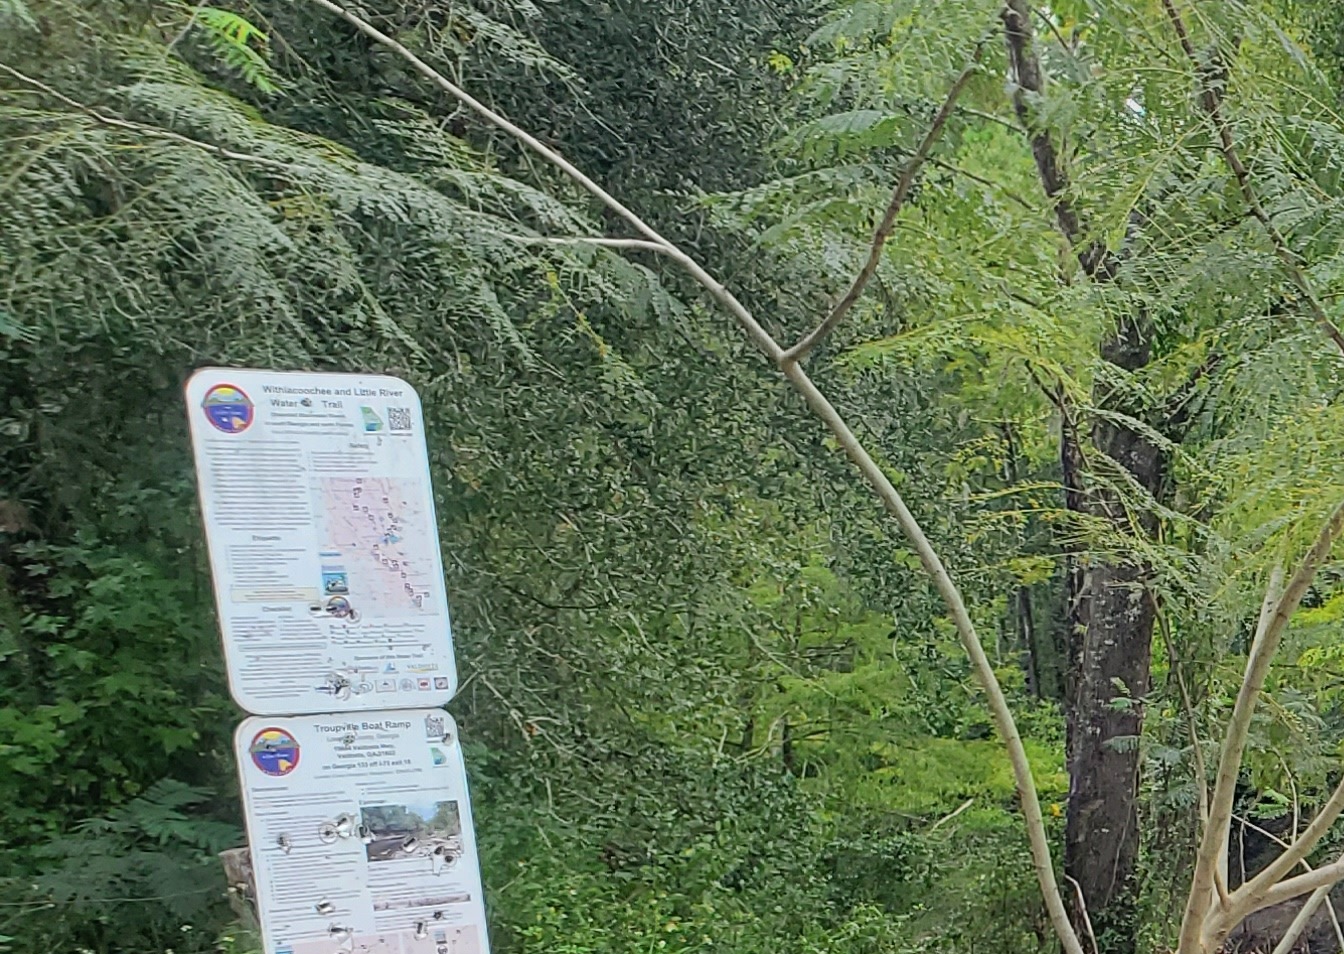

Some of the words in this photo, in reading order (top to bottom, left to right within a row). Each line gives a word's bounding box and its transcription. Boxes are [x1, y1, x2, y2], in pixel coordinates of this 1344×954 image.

[335, 388, 351, 396] and
[354, 388, 377, 397] Little
[380, 389, 403, 397] River
[271, 400, 298, 408] Water
[322, 401, 343, 409] Trail
[314, 724, 359, 733] Troupville
[361, 722, 382, 730] Boat
[385, 721, 411, 730] Ramp
